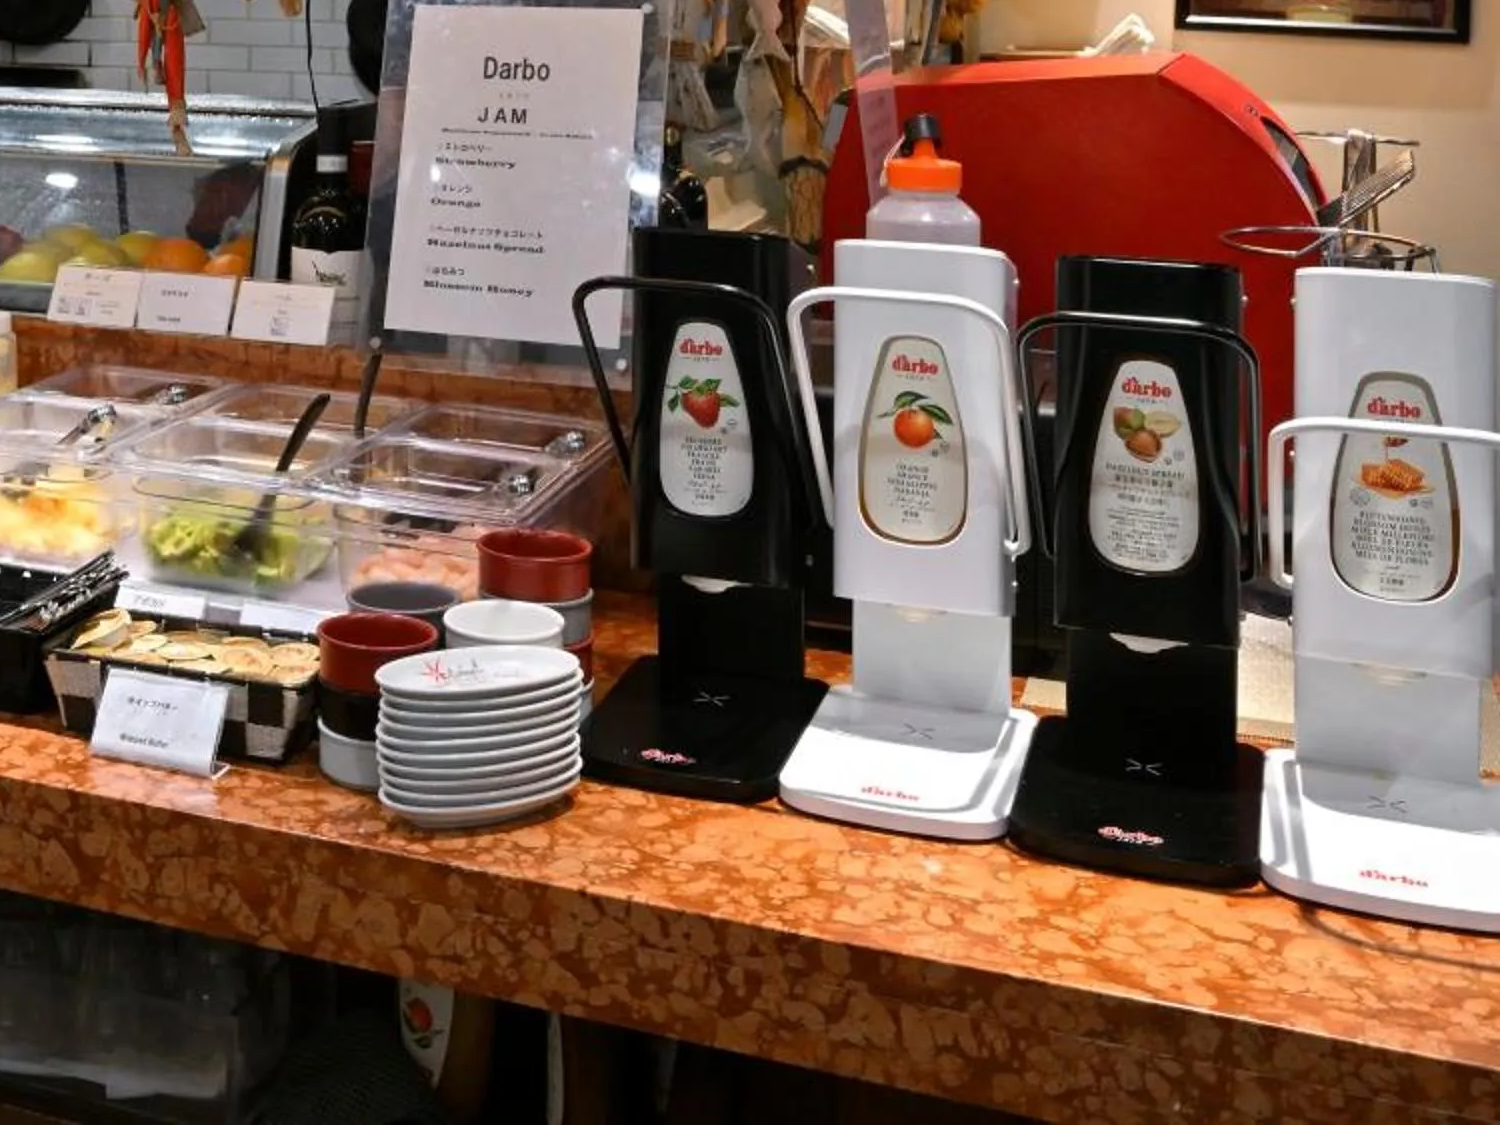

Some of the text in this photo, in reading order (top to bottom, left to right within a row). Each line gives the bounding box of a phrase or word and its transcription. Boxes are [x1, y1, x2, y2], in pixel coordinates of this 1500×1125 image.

[483, 56, 551, 81] Darbo
[477, 106, 528, 124] JAM
[435, 156, 517, 170] Strawberry
[430, 197, 482, 209] Orange
[426, 237, 545, 254] Hazelnut Spread
[423, 279, 533, 297] Blossom Honey
